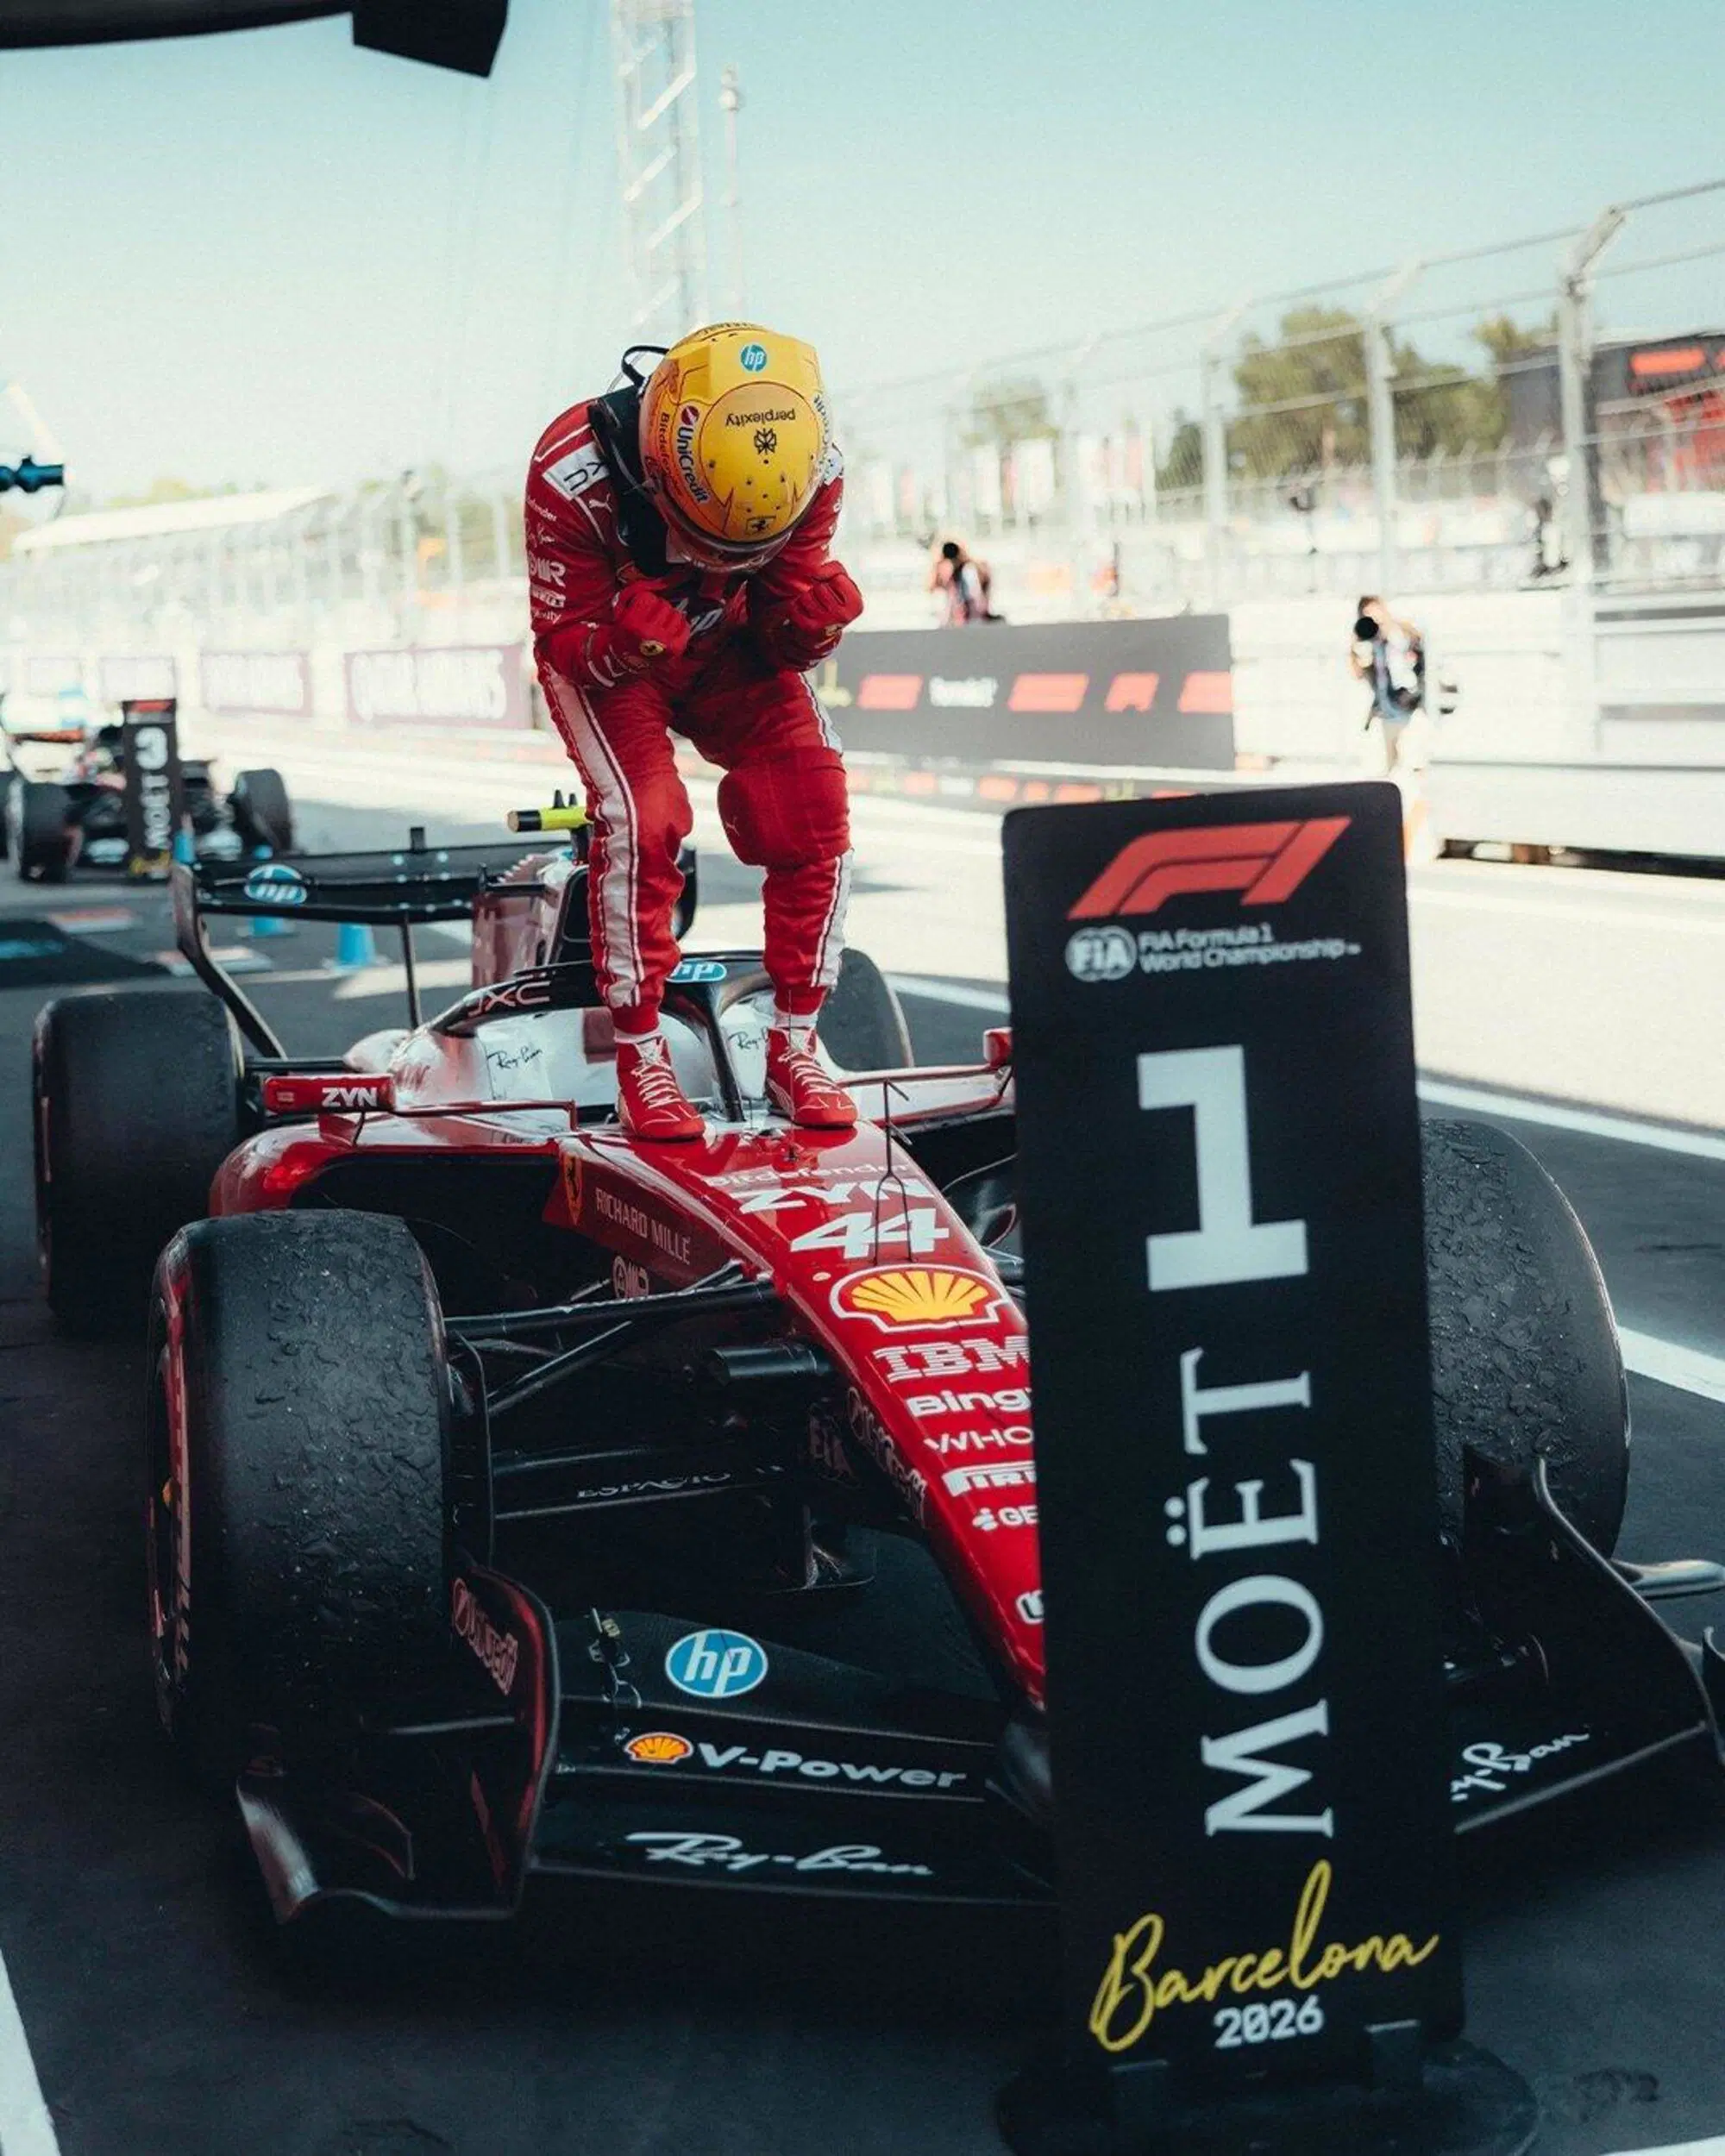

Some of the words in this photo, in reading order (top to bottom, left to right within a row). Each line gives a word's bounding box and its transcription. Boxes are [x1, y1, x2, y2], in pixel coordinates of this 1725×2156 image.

[744, 344, 765, 372] hp
[724, 408, 797, 427] perplexity
[676, 425, 710, 503] UniCredit
[135, 726, 169, 770] 3
[1066, 815, 1352, 921] F1
[1072, 937, 1131, 973] FIA
[1176, 925, 1259, 950] Formula
[1261, 922, 1273, 943] 1
[1138, 950, 1202, 974] World
[322, 1087, 378, 1107] ZYN
[1138, 1045, 1309, 1293] 1
[730, 1178, 937, 1214] ZYN
[595, 1187, 649, 1239] RICHARD
[650, 1219, 691, 1266] MILLE
[790, 1208, 950, 1260] 44
[872, 1336, 1030, 1383] IBM
[906, 1387, 1032, 1418] Bing
[924, 1426, 1034, 1454] WHO
[943, 1459, 1037, 1497] PIR
[1164, 1346, 1333, 1839] MOËT
[684, 1629, 752, 1698] hp
[693, 1743, 967, 1787] V-Power
[624, 1832, 933, 1876] Ray-Ban
[1088, 1859, 1440, 2052] Barcelona
[1214, 1995, 1325, 2049] 2026
